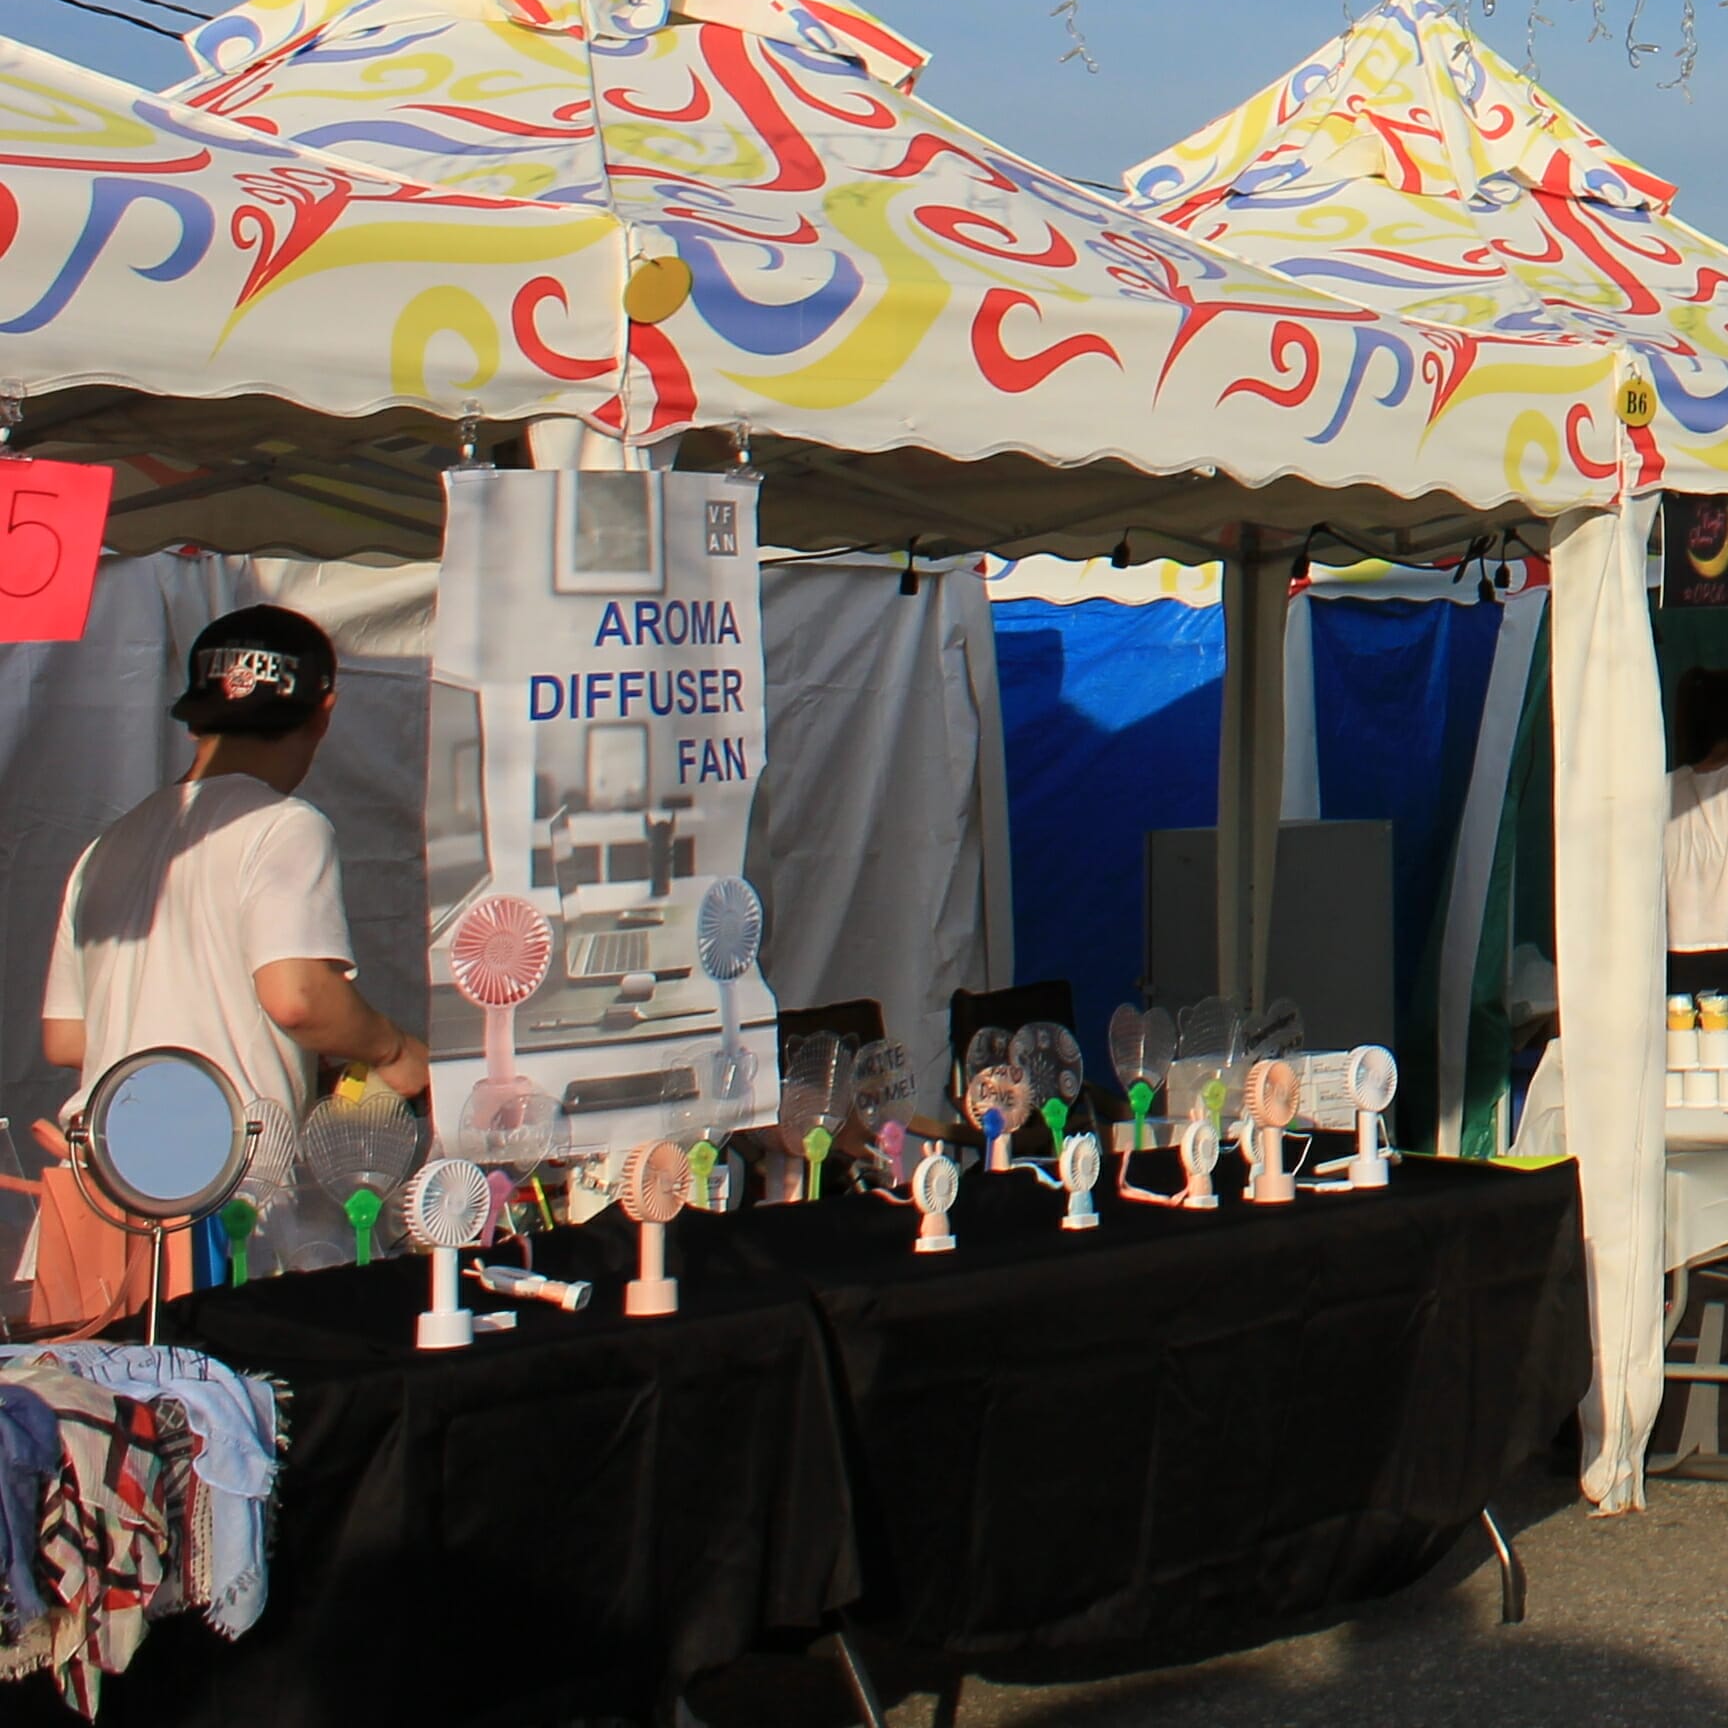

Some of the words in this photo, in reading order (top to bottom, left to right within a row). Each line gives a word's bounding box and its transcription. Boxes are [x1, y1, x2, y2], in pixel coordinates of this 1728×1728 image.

[1626, 389, 1648, 416] B6
[594, 599, 742, 648] AROMA
[528, 668, 745, 722] DIFFUSER
[676, 737, 748, 785] FAN
